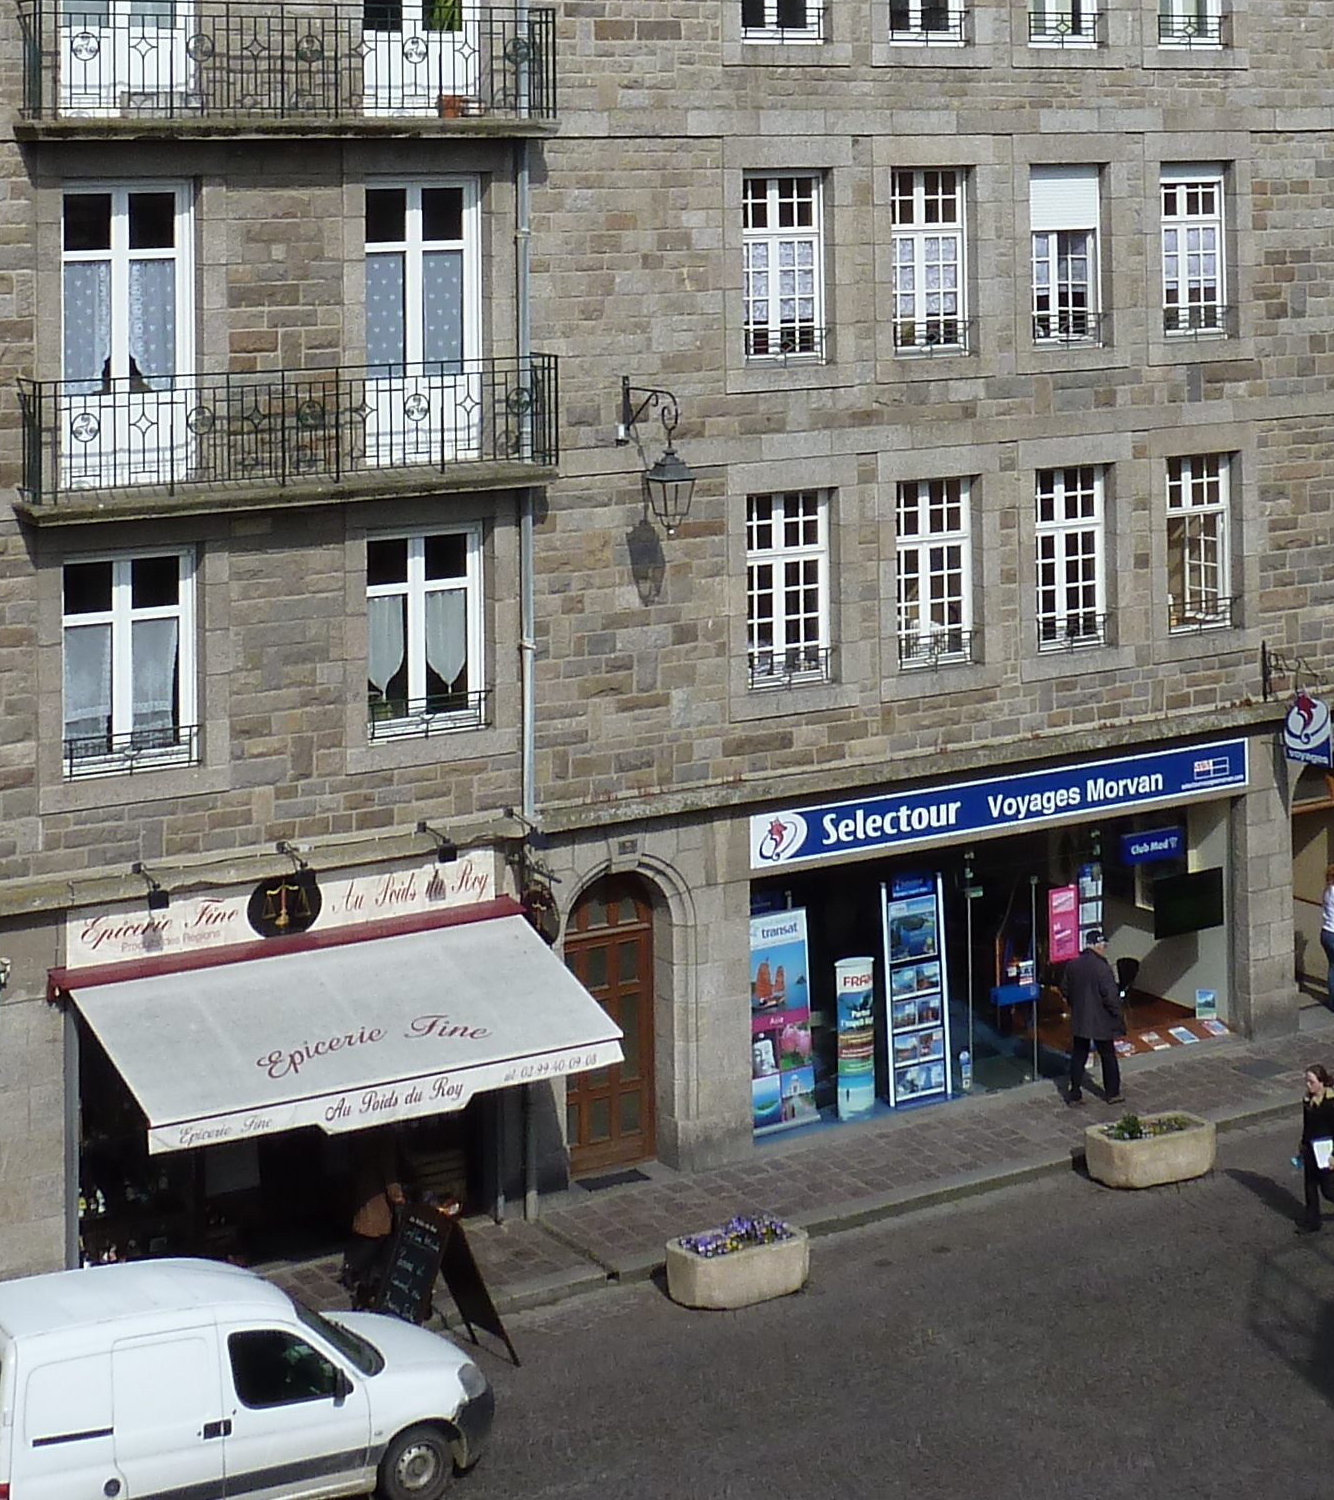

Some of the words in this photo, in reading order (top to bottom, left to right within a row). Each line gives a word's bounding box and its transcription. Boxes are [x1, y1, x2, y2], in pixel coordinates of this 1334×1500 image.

[987, 786, 1081, 819] Voyages
[1085, 772, 1164, 803] Morvan
[822, 801, 962, 845] Selectour
[1130, 842, 1150, 856] Club
[1150, 838, 1169, 852] Med
[331, 880, 365, 914] Au
[374, 872, 419, 908] Poids
[424, 869, 445, 895] du
[451, 859, 489, 900] Roy
[81, 914, 173, 950] Epicerie
[189, 898, 240, 928] Fine
[761, 922, 798, 939] transat
[256, 1025, 387, 1079] Epicerie
[404, 1015, 492, 1040] Fine
[325, 1096, 352, 1122] Au
[359, 1090, 399, 1115] Poids
[404, 1084, 423, 1104] du
[429, 1076, 465, 1101] Roy
[178, 1126, 233, 1146] Epicerie
[239, 1115, 273, 1134] Fine
